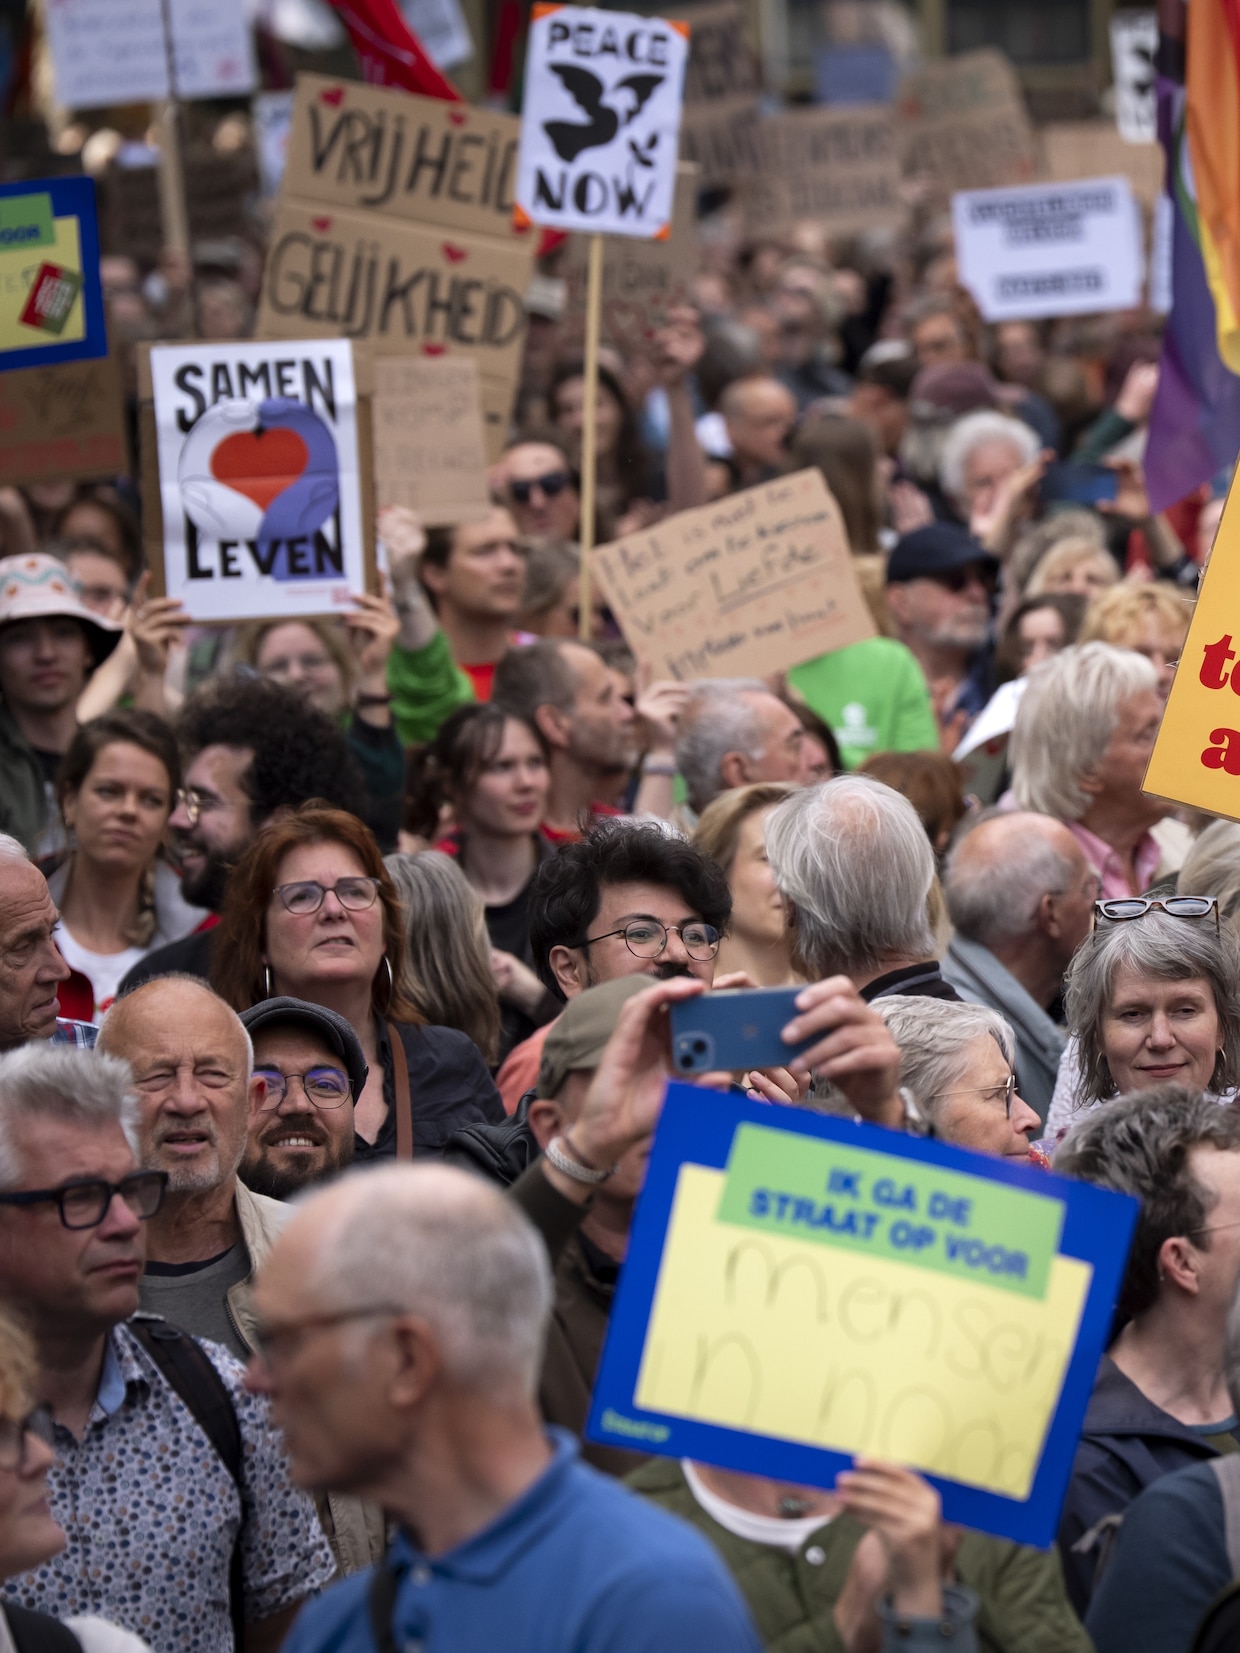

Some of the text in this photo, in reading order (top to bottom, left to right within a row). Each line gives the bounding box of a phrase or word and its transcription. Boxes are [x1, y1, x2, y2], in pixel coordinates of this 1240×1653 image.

[549, 22, 668, 66] PEACE
[534, 168, 656, 219] NOW
[0, 222, 42, 244] OOR
[267, 230, 527, 348] GELIJKHEID
[173, 357, 337, 435] SAMEN
[184, 500, 345, 580] LEVEN
[826, 1165, 972, 1228] IK GA DE
[750, 1186, 1030, 1282] STRAAT OP VOOR
